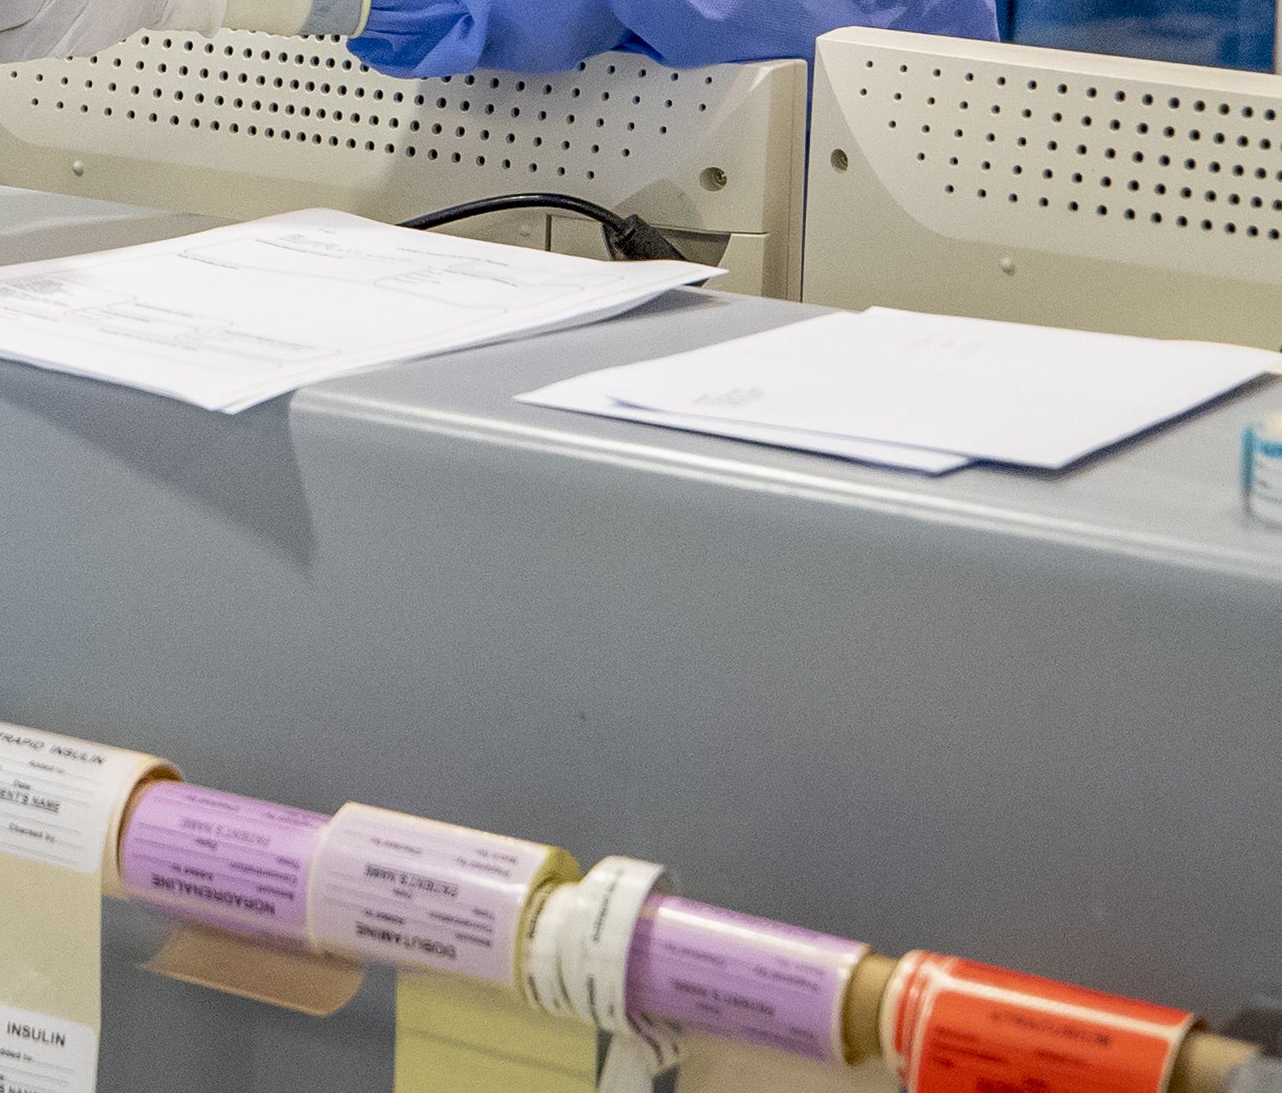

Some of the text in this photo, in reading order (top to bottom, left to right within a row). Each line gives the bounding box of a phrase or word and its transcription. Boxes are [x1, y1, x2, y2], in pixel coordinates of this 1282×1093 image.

[48, 743, 106, 766] INSULIN
[31, 795, 61, 814] NAME
[6, 1020, 67, 1048] INSULIN
